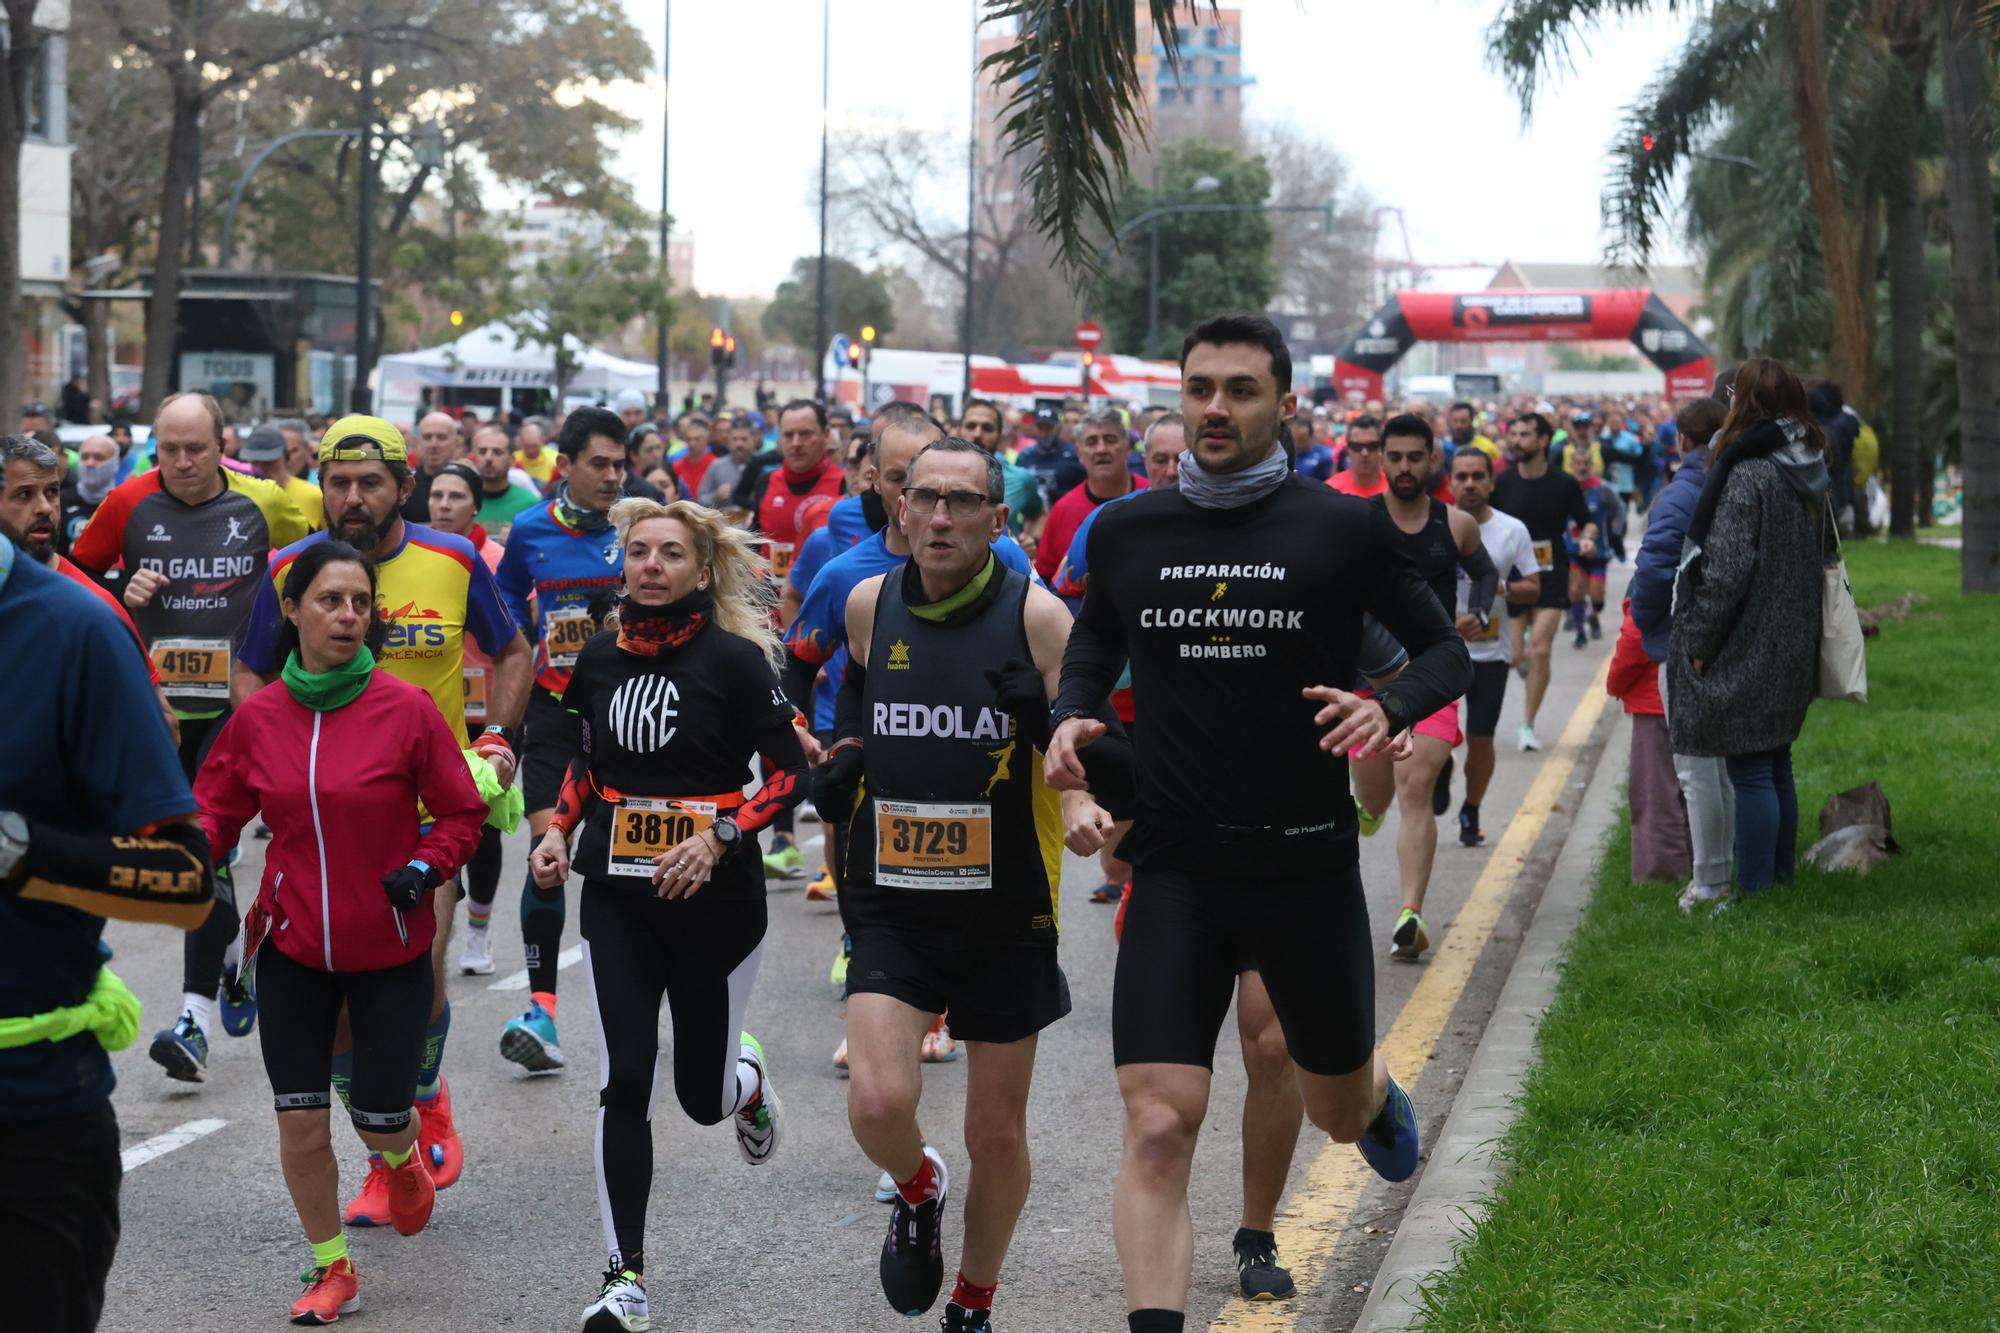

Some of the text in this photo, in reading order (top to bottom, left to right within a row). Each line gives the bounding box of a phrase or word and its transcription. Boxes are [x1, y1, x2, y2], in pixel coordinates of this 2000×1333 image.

[203, 359, 255, 378] TOUS
[169, 556, 254, 579] GALENO
[1160, 562, 1286, 580] PREPARACIÓN
[161, 595, 228, 610] Valencia
[1140, 608, 1304, 629] CLOCKWORK
[553, 620, 593, 644] 386
[162, 651, 213, 674] 4157
[1180, 644, 1267, 659] BOMBERO
[608, 673, 680, 754] NIKE
[626, 812, 694, 846] 3810
[893, 818, 967, 855] 3729
